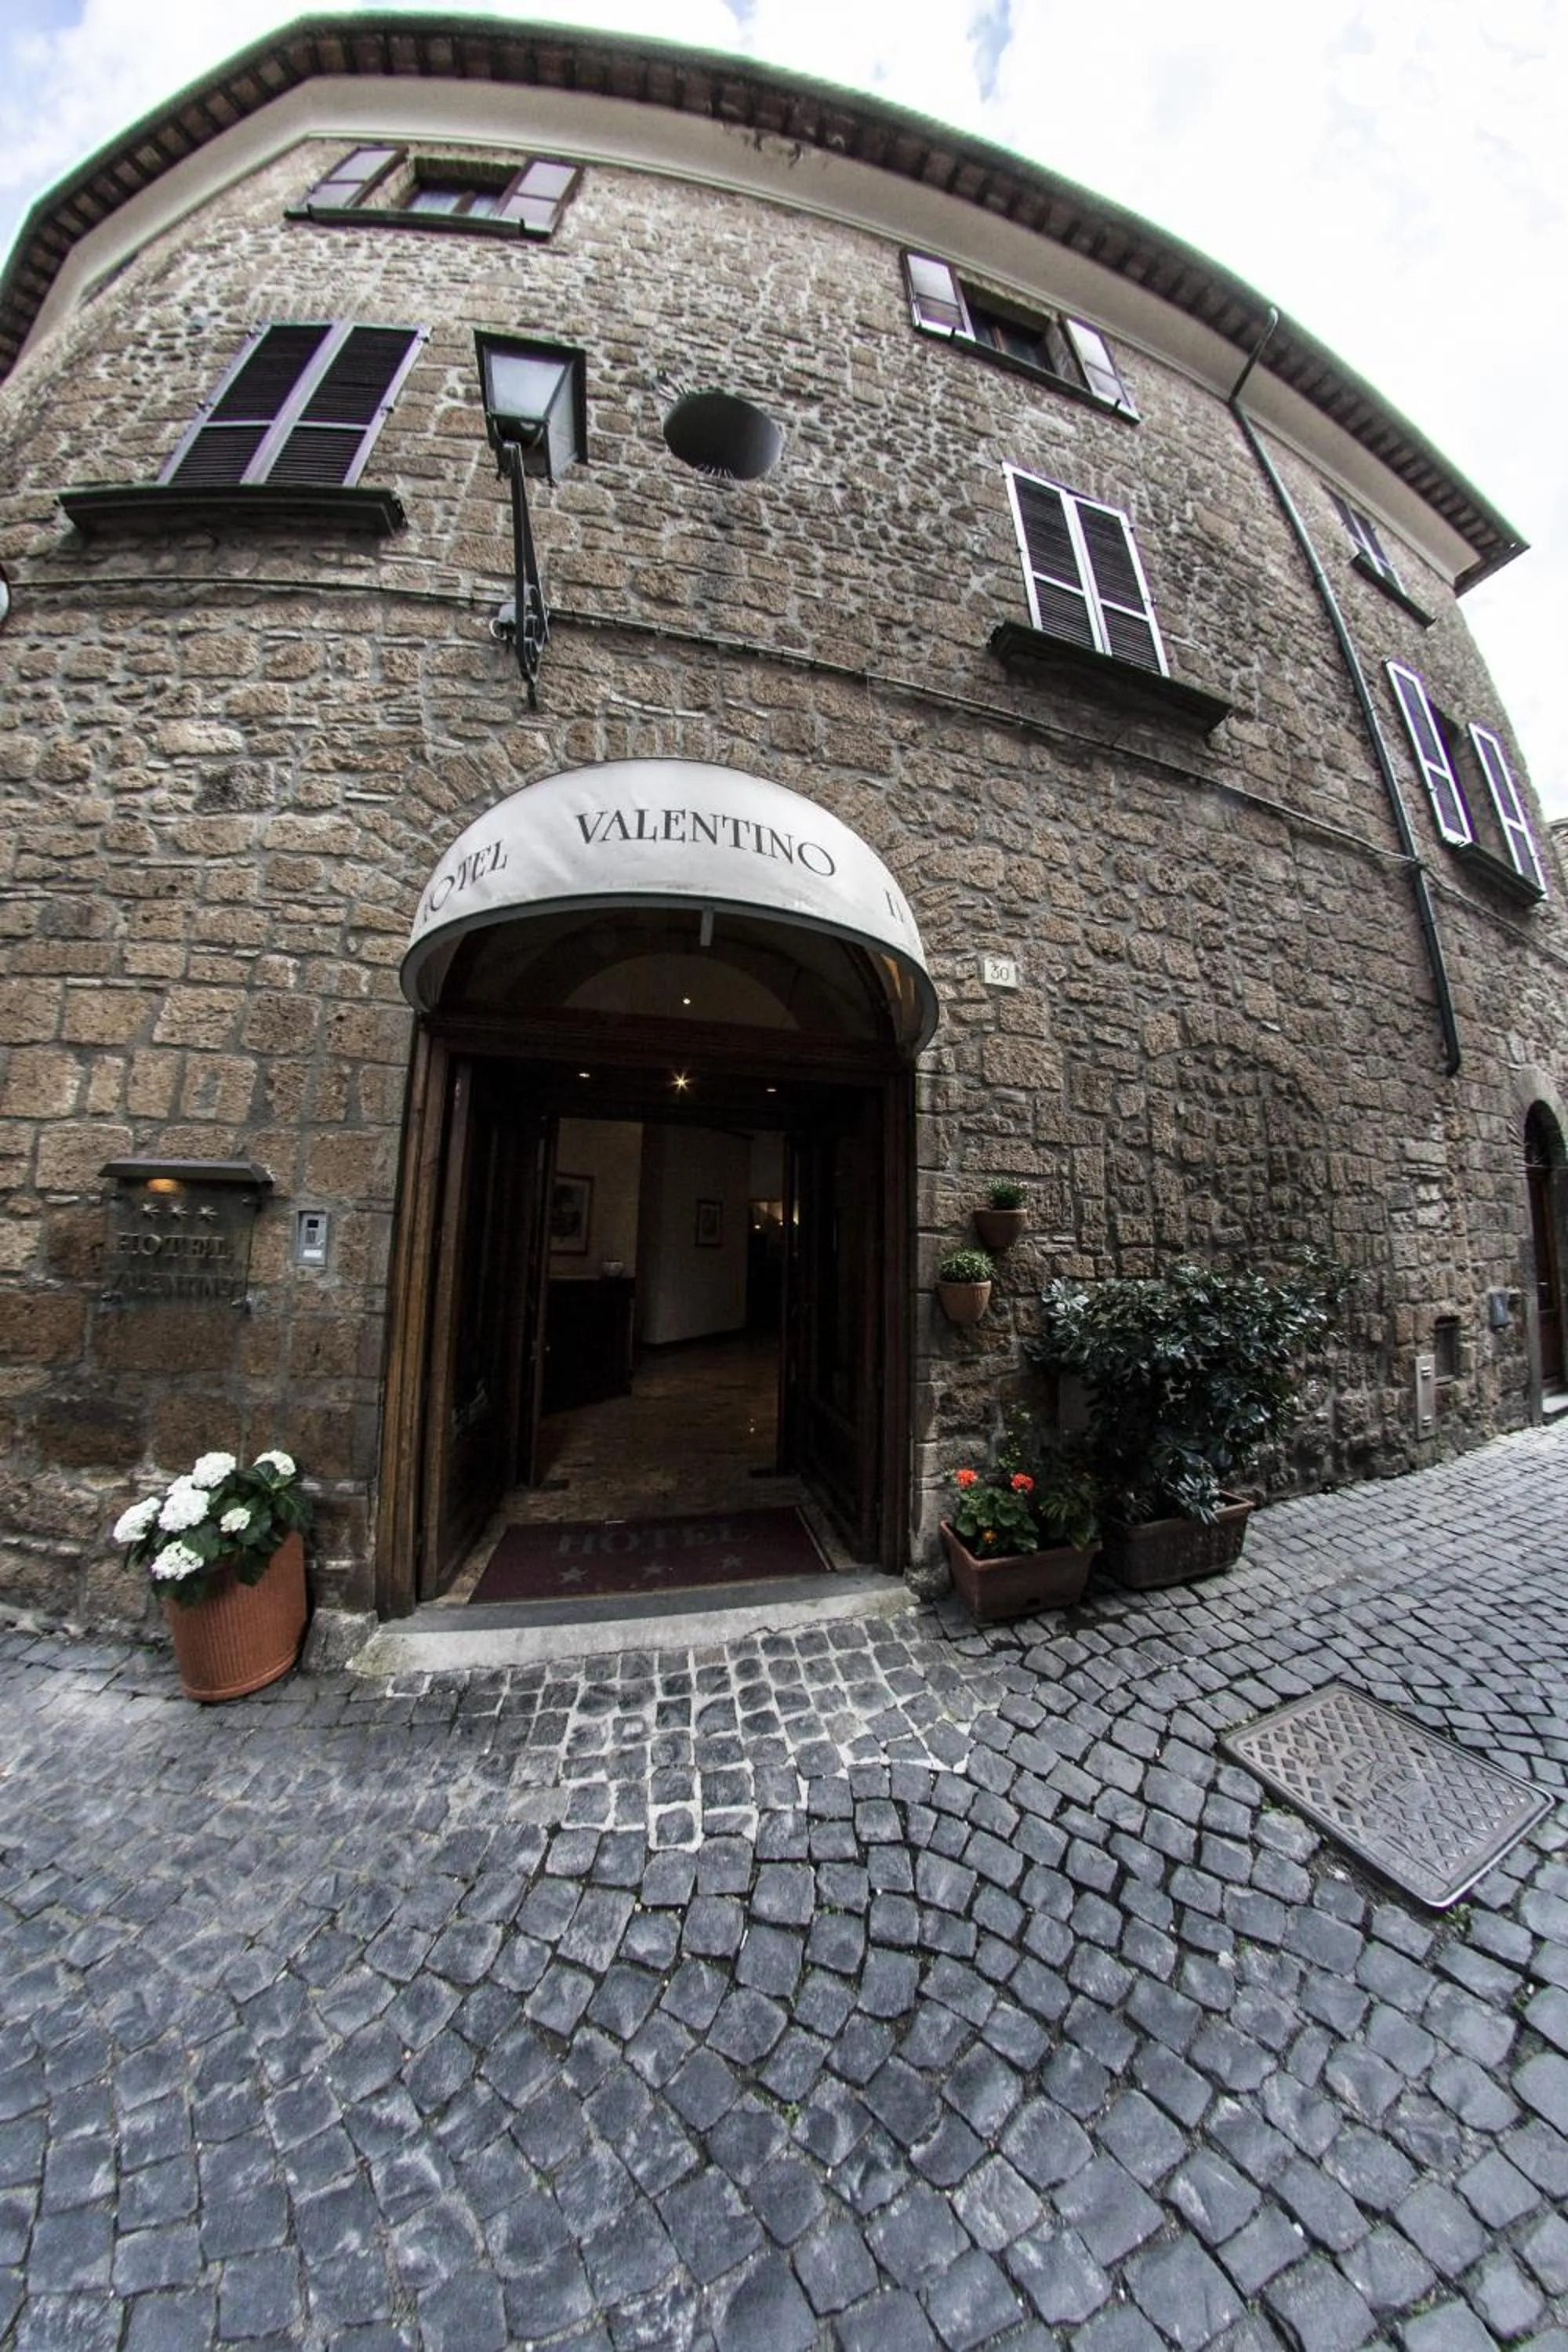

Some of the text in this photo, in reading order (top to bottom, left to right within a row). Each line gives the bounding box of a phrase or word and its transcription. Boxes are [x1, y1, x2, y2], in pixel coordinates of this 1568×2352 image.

[575, 808, 836, 877] VALENTINO
[114, 1231, 227, 1259] HOTEL
[558, 1523, 753, 1555] HOTEL
